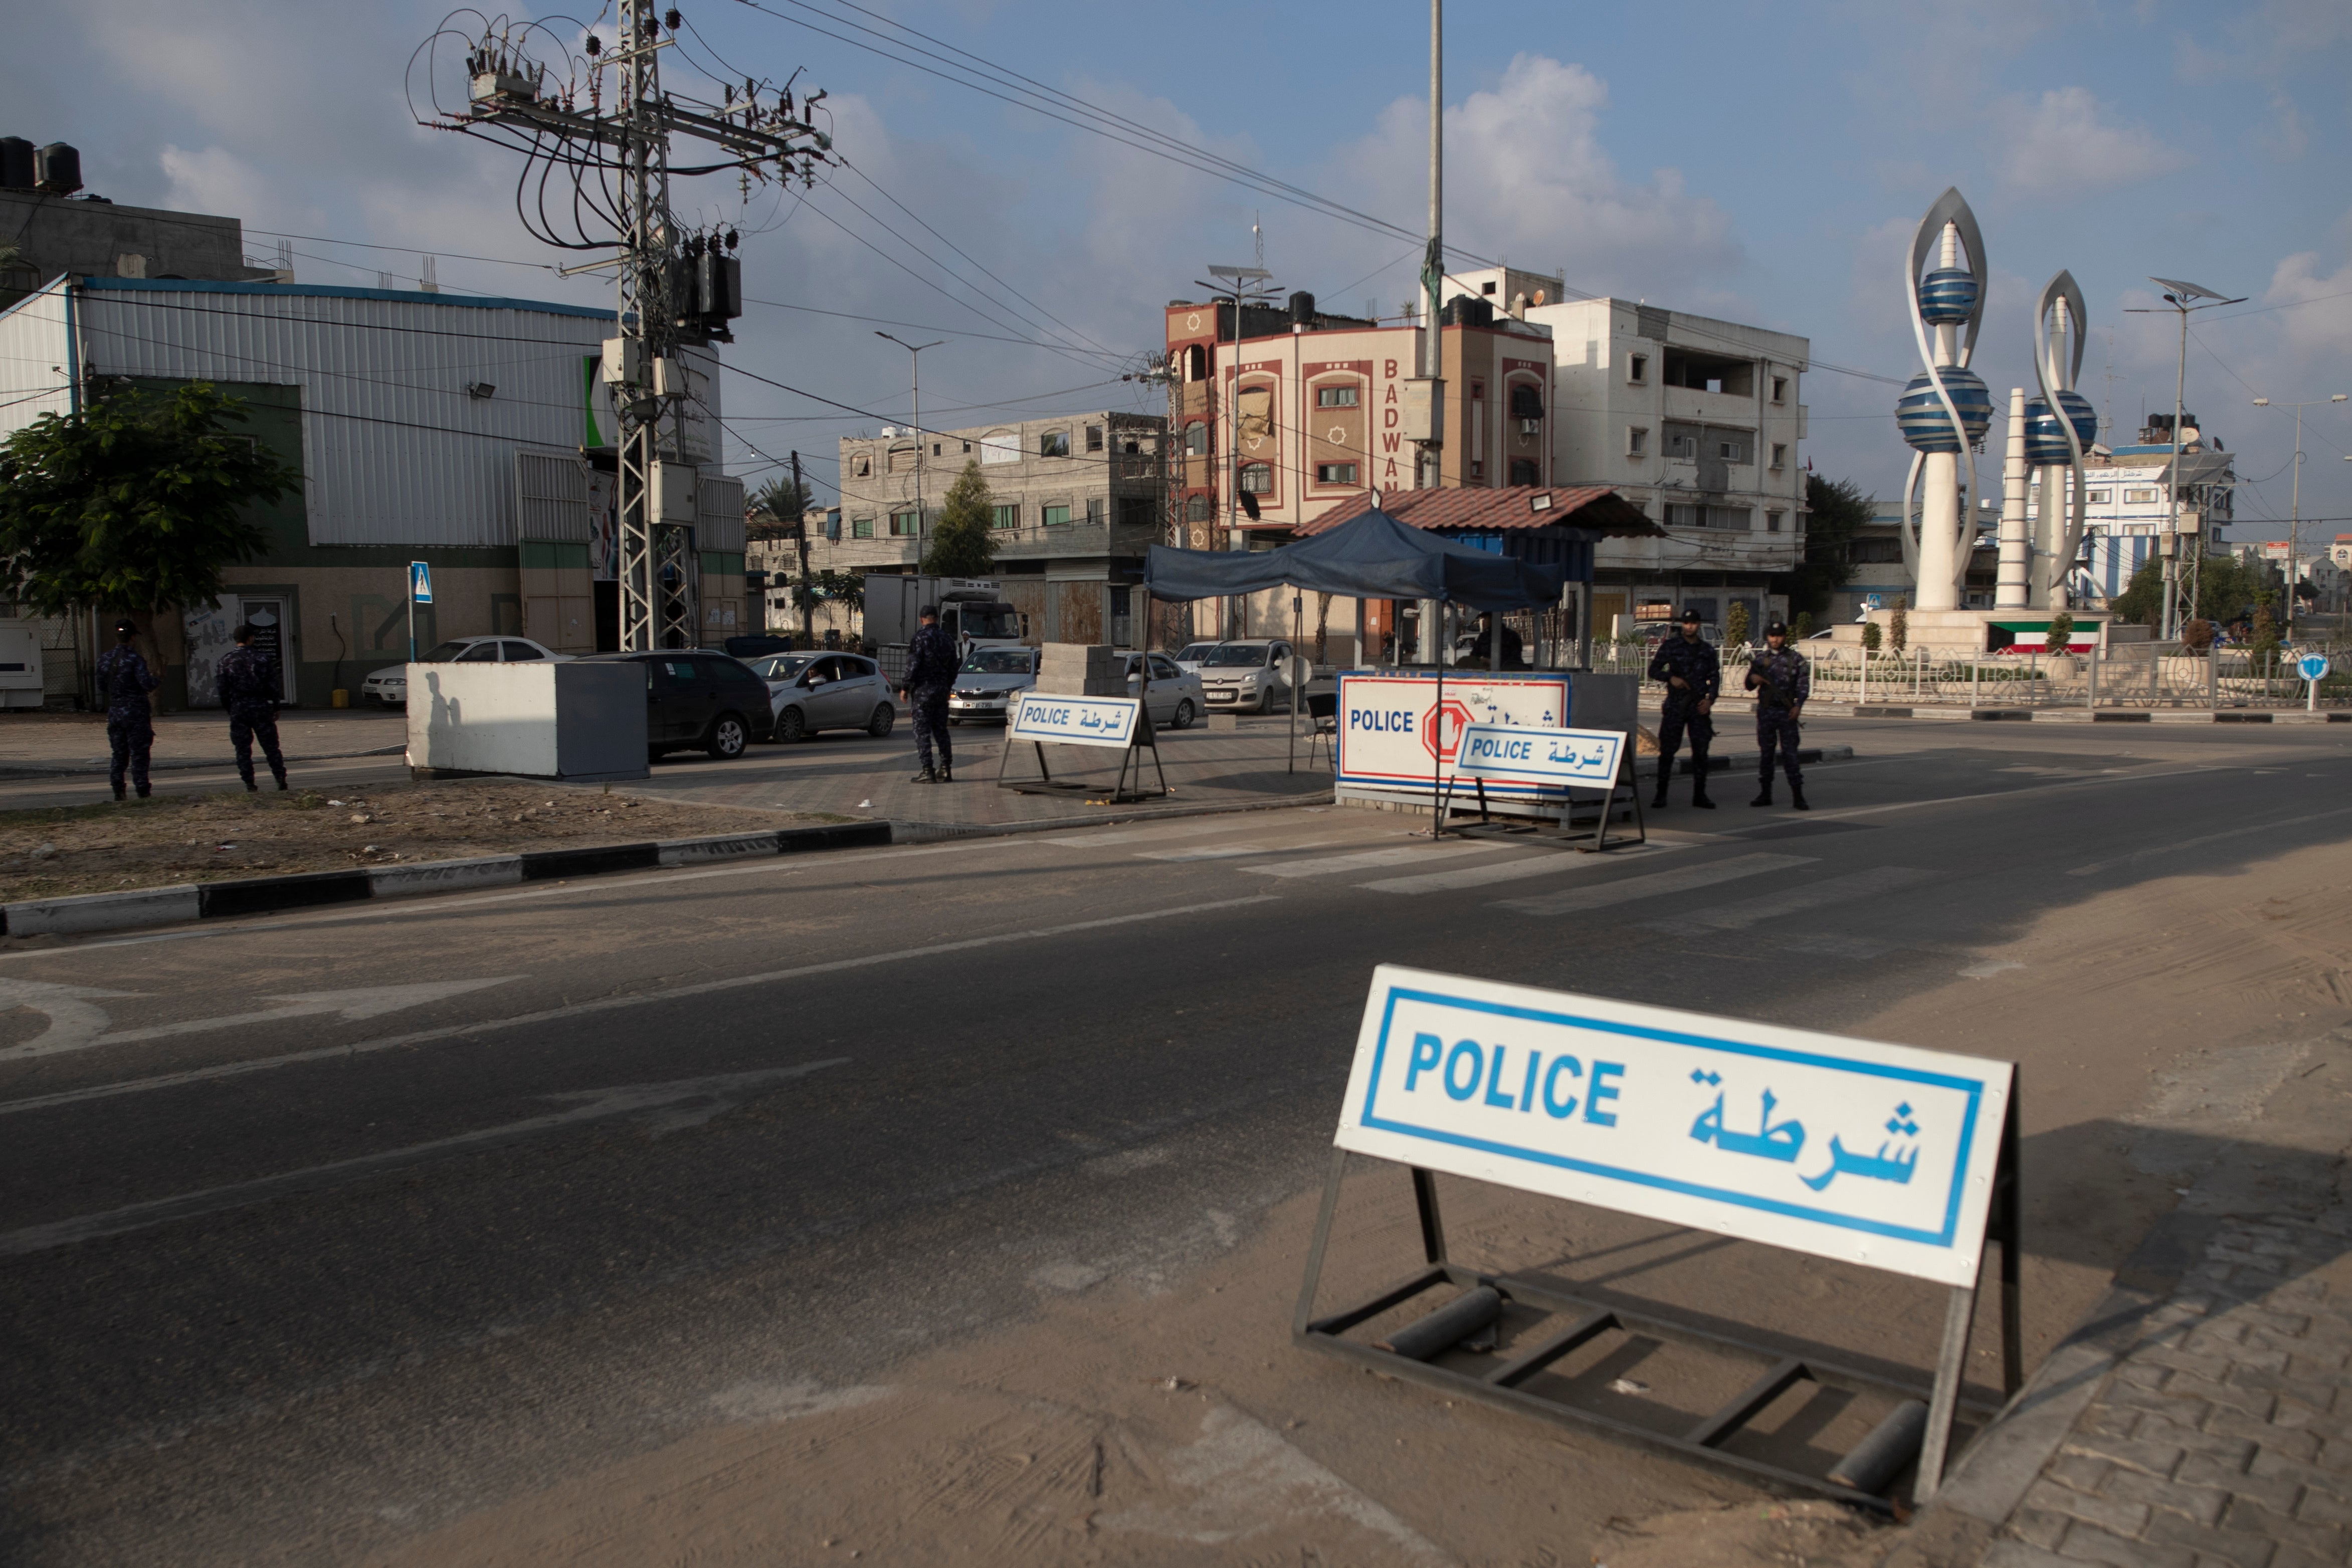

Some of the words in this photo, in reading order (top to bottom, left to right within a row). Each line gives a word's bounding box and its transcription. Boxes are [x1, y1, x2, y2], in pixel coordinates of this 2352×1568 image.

[1024, 707, 1070, 725] POLICE
[1080, 709, 1121, 733] شرطة
[1351, 709, 1413, 732] POLICE
[1471, 738, 1532, 759] POLICE
[1548, 741, 1604, 770] شرطة
[1404, 1031, 1626, 1127] POLICE
[1688, 1067, 1921, 1192] شرطة
